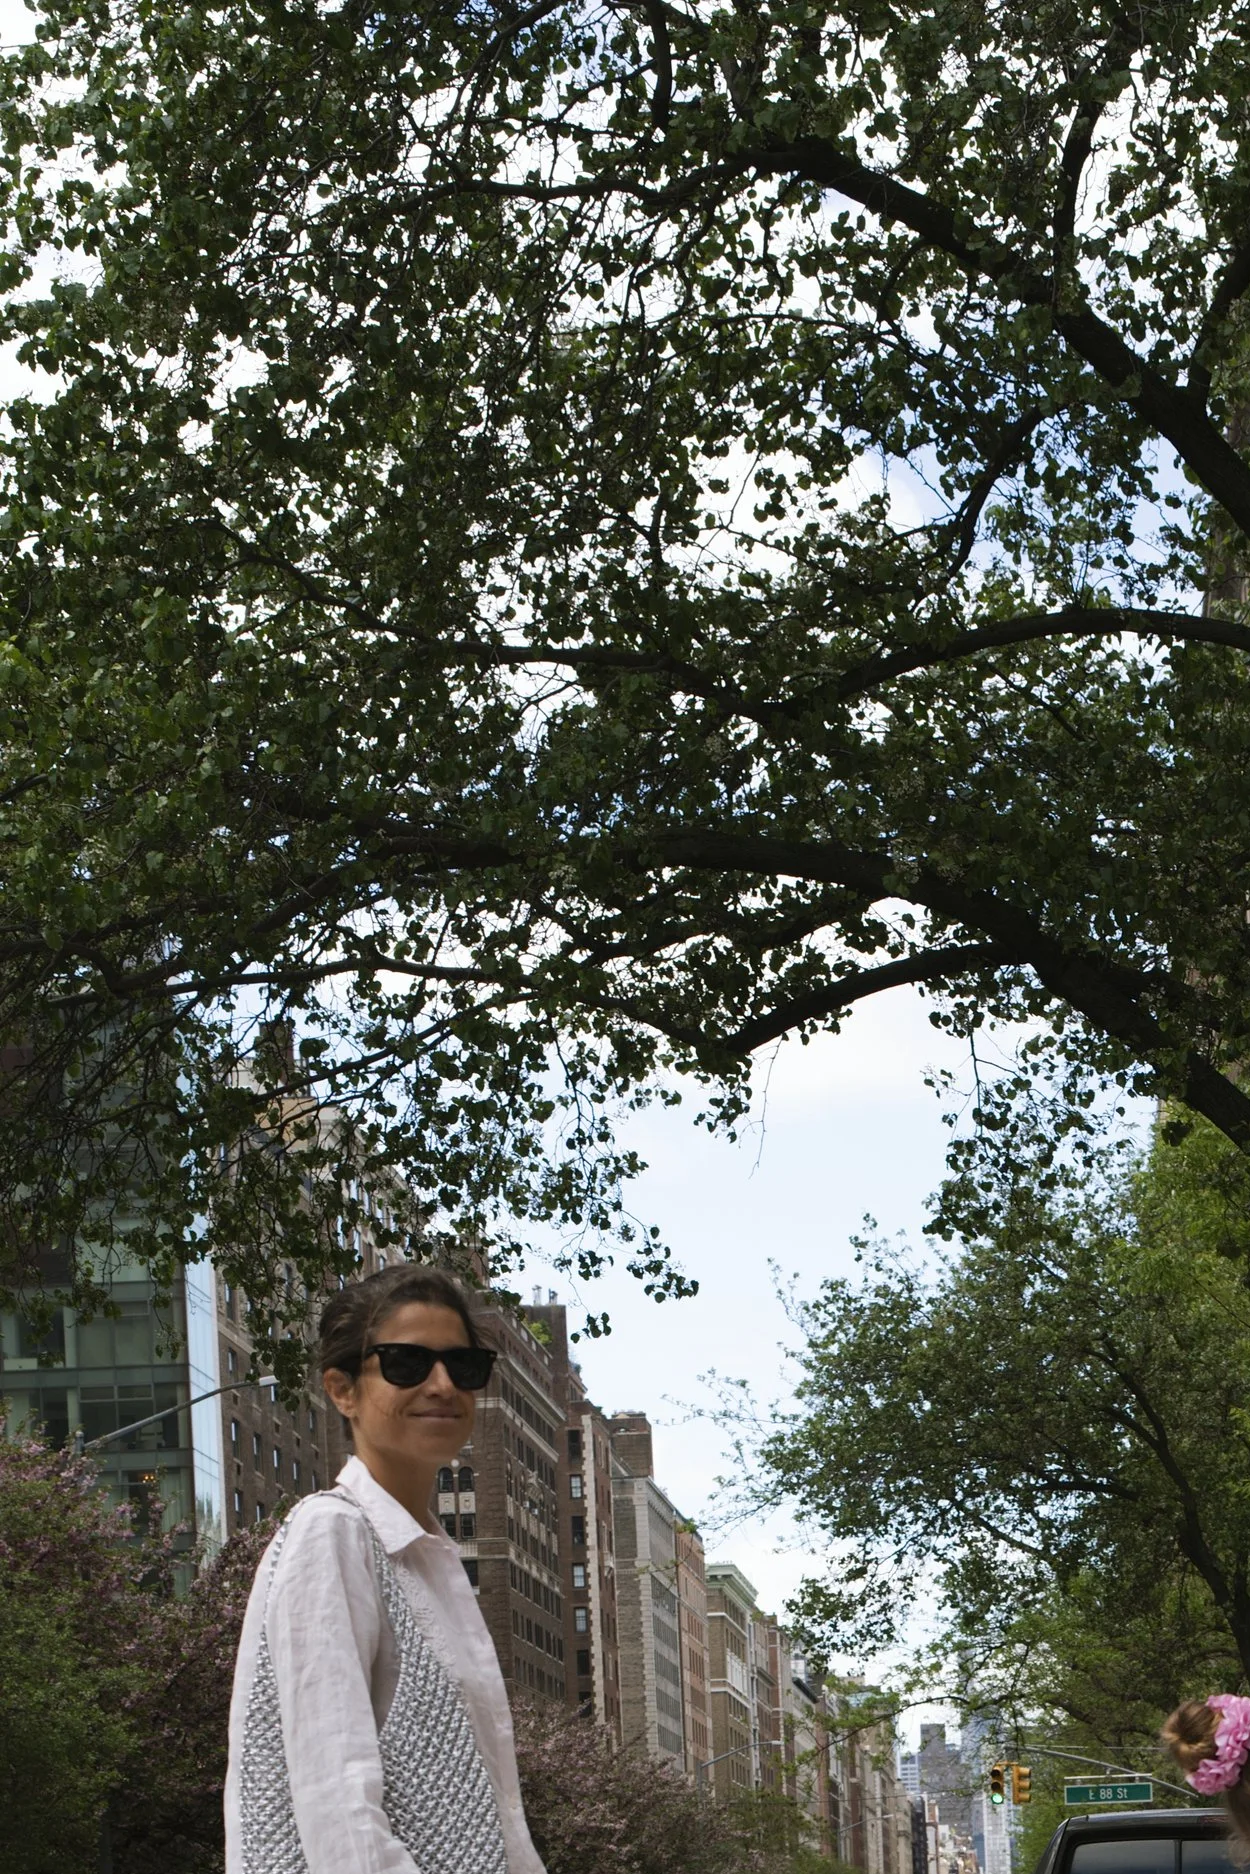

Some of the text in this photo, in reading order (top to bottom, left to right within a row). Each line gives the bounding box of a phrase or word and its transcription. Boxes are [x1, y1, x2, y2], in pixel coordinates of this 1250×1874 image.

[1088, 1787, 1128, 1800] E 88 St
